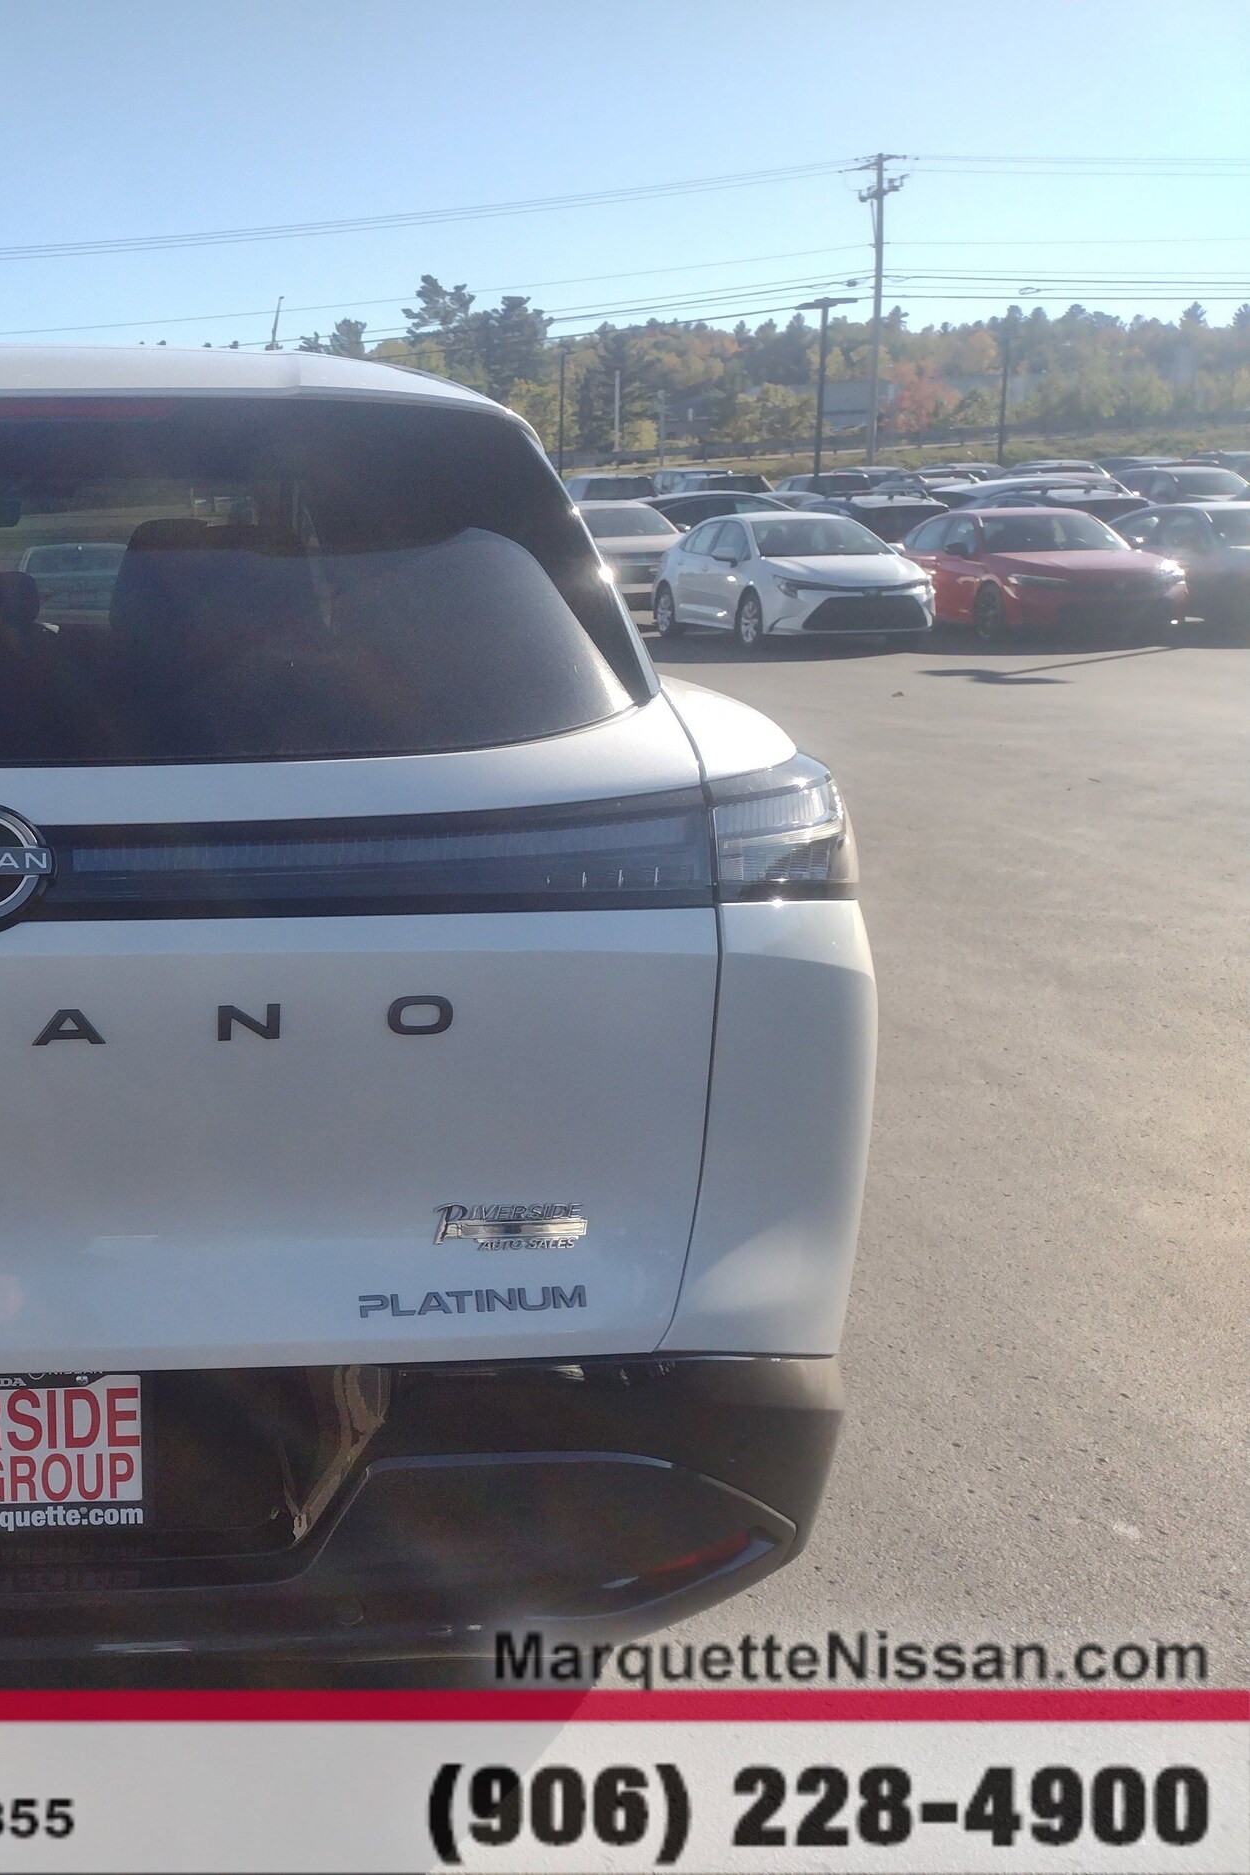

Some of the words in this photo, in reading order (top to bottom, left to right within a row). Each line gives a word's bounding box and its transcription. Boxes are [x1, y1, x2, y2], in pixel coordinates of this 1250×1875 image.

[434, 1202, 584, 1245] RIVERSIDE
[478, 1238, 526, 1250] AUTO
[526, 1236, 576, 1249] SALES
[358, 1285, 587, 1318] PLATINUM
